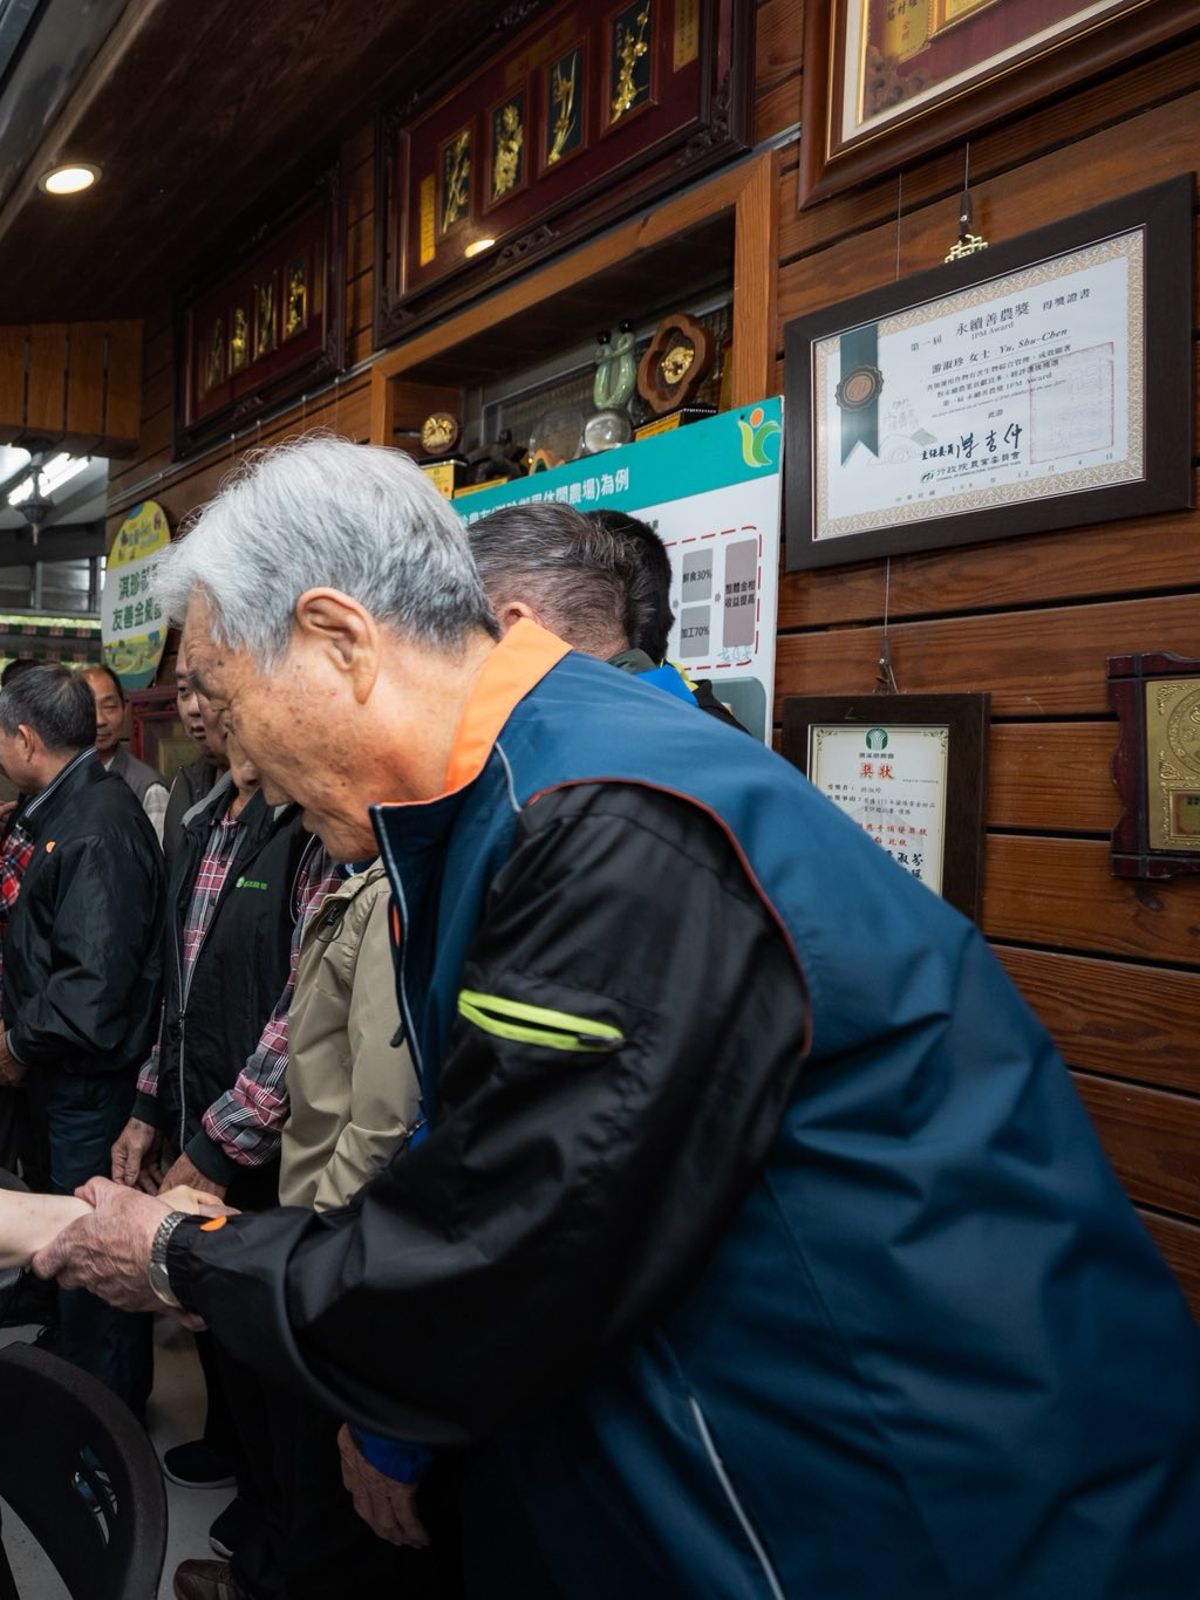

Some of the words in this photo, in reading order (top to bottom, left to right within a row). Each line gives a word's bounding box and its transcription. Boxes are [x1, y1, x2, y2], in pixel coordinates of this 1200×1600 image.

[956, 301, 1031, 336] 永續善農獎
